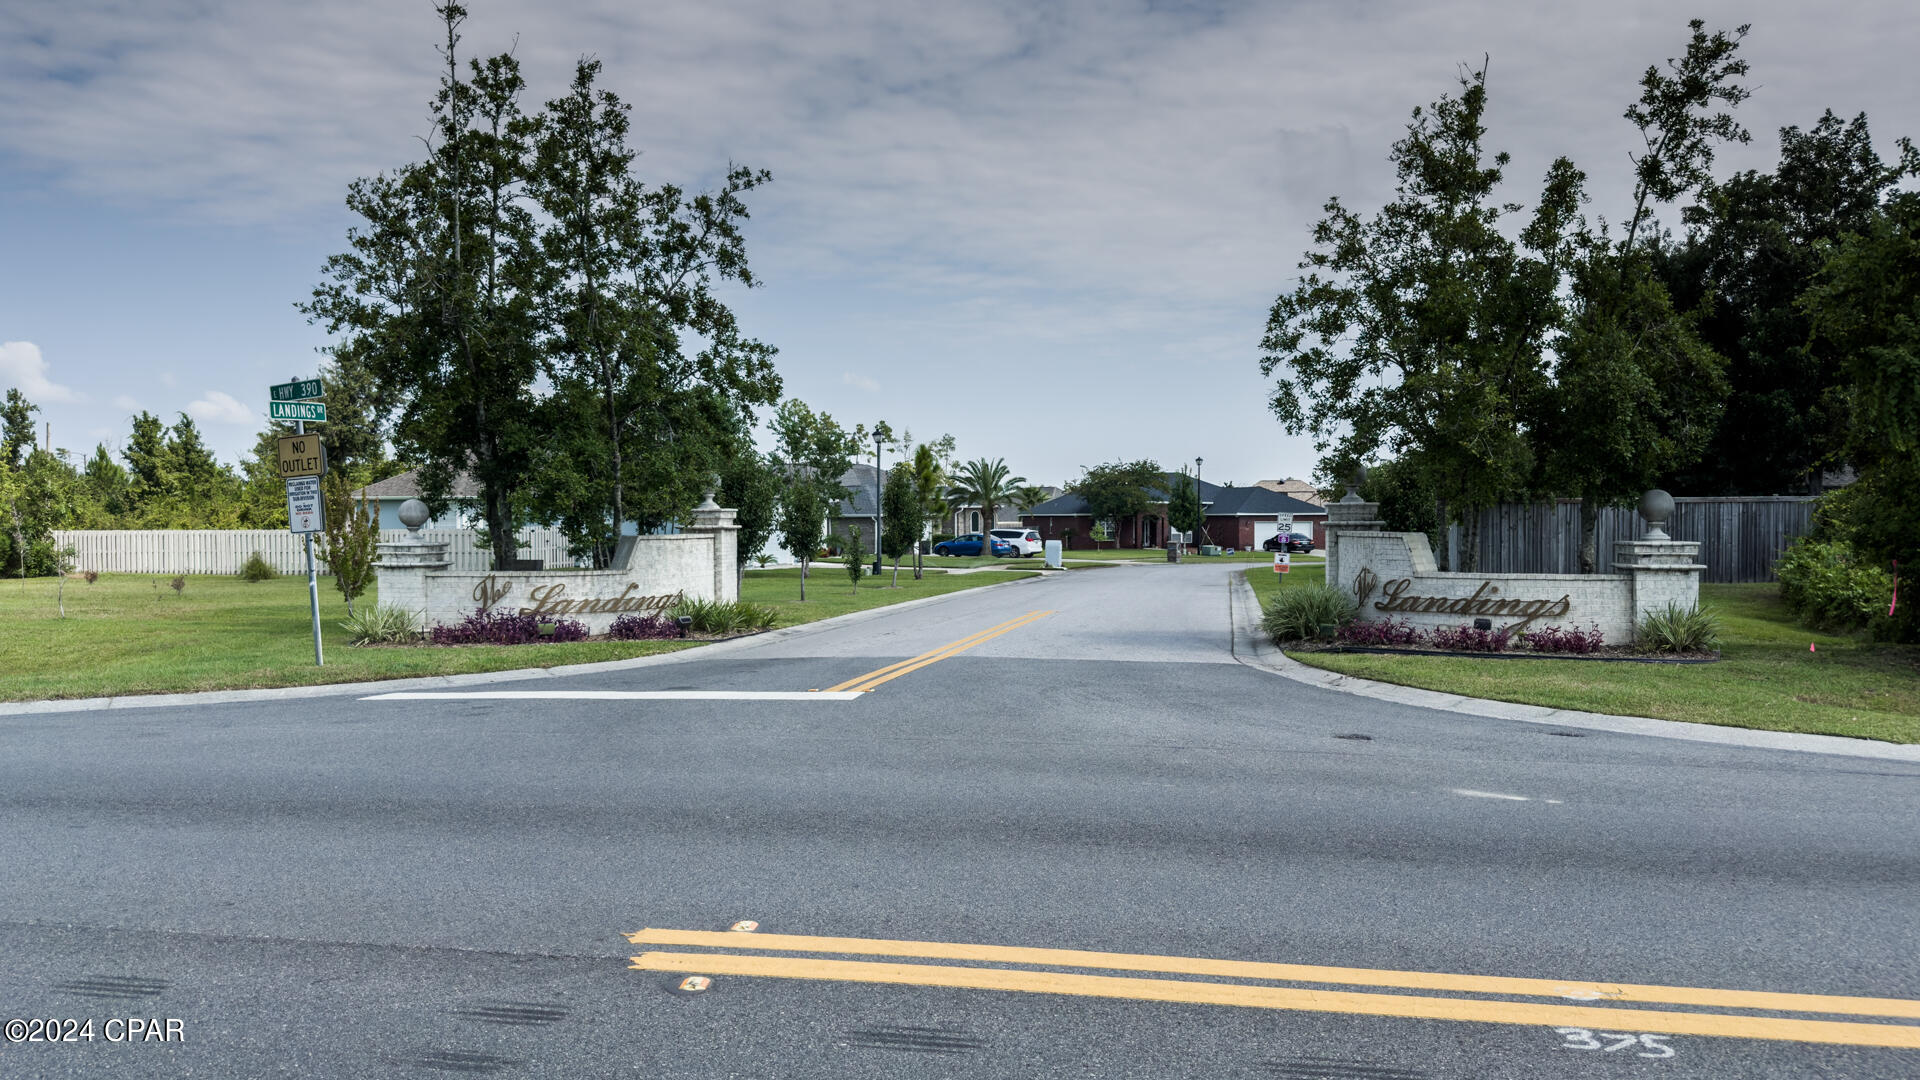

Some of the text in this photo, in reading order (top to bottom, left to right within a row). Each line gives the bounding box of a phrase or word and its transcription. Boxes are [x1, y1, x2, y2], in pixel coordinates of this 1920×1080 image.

[279, 385, 293, 400] HWY
[300, 381, 318, 397] 390
[273, 403, 316, 418] LANDINGS
[292, 440, 306, 455] NO
[282, 457, 318, 473] OUTLET
[1278, 523, 1291, 531] 25
[519, 582, 684, 618] Landings
[1374, 578, 1570, 635] Landings
[1555, 1028, 1675, 1058] 375
